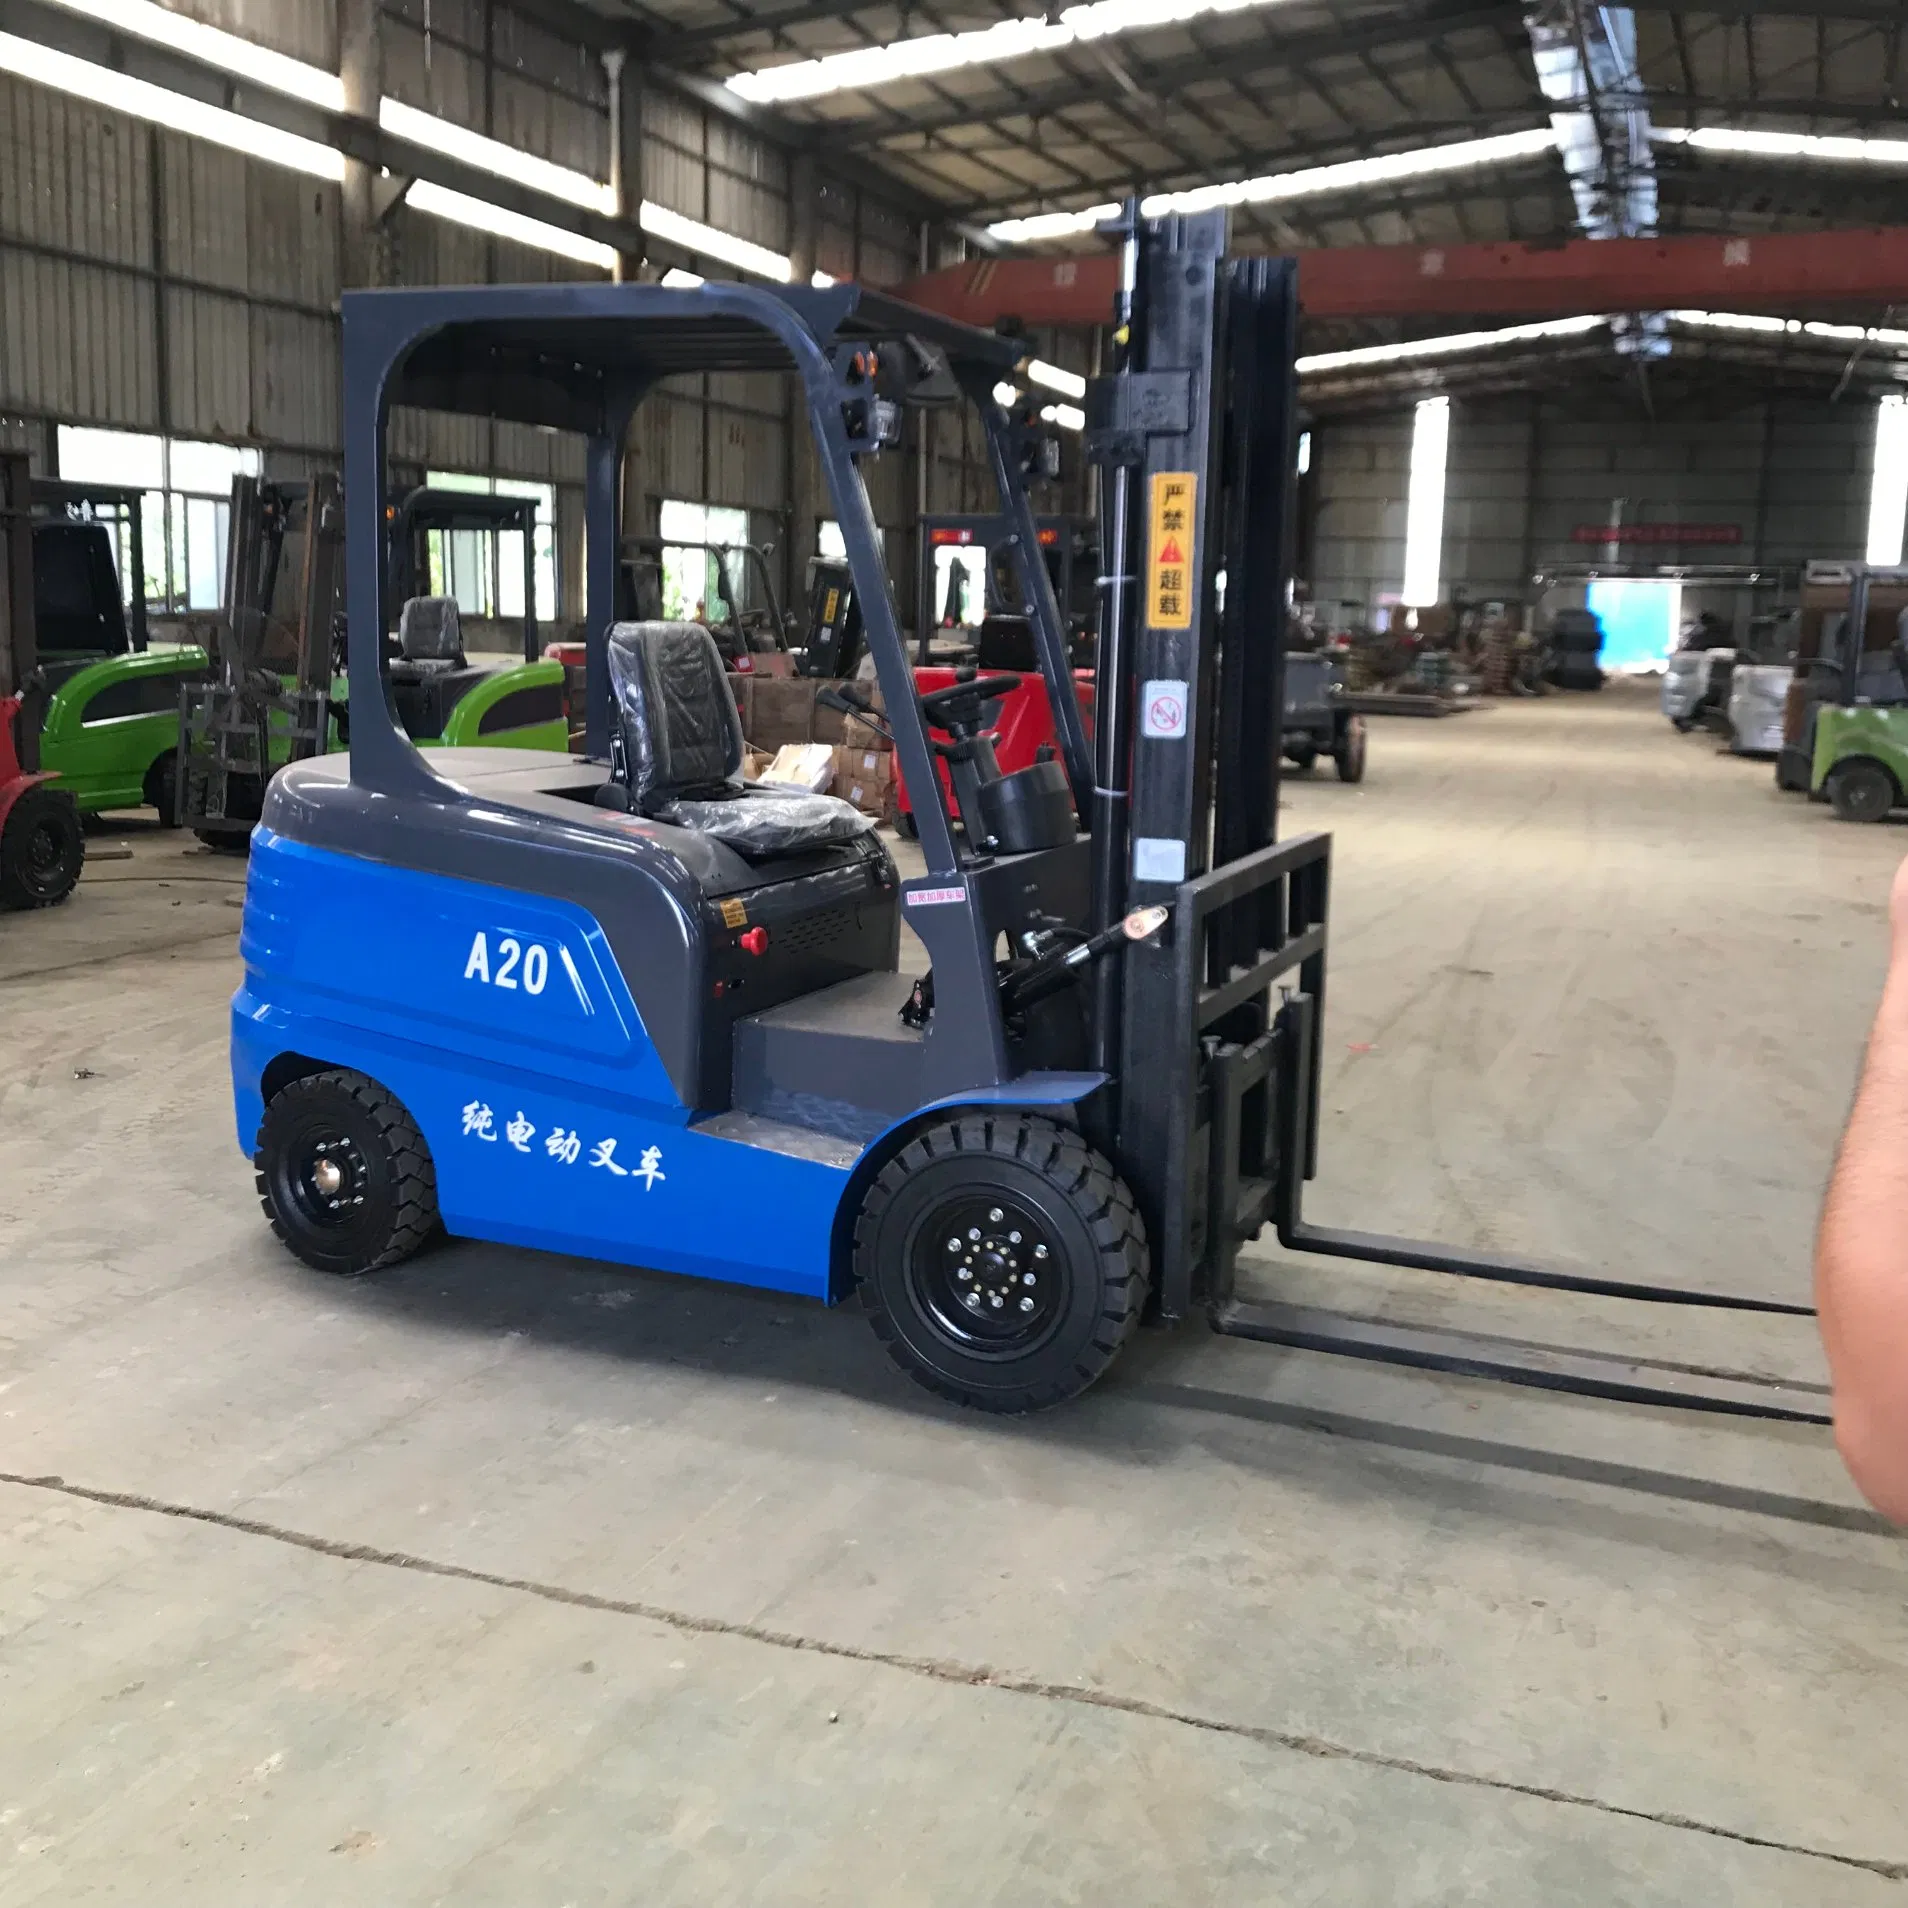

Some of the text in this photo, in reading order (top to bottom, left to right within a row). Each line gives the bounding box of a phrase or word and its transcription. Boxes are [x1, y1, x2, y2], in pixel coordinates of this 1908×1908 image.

[464, 931, 548, 995] A20
[461, 1100, 666, 1192] 纯电动叉车
